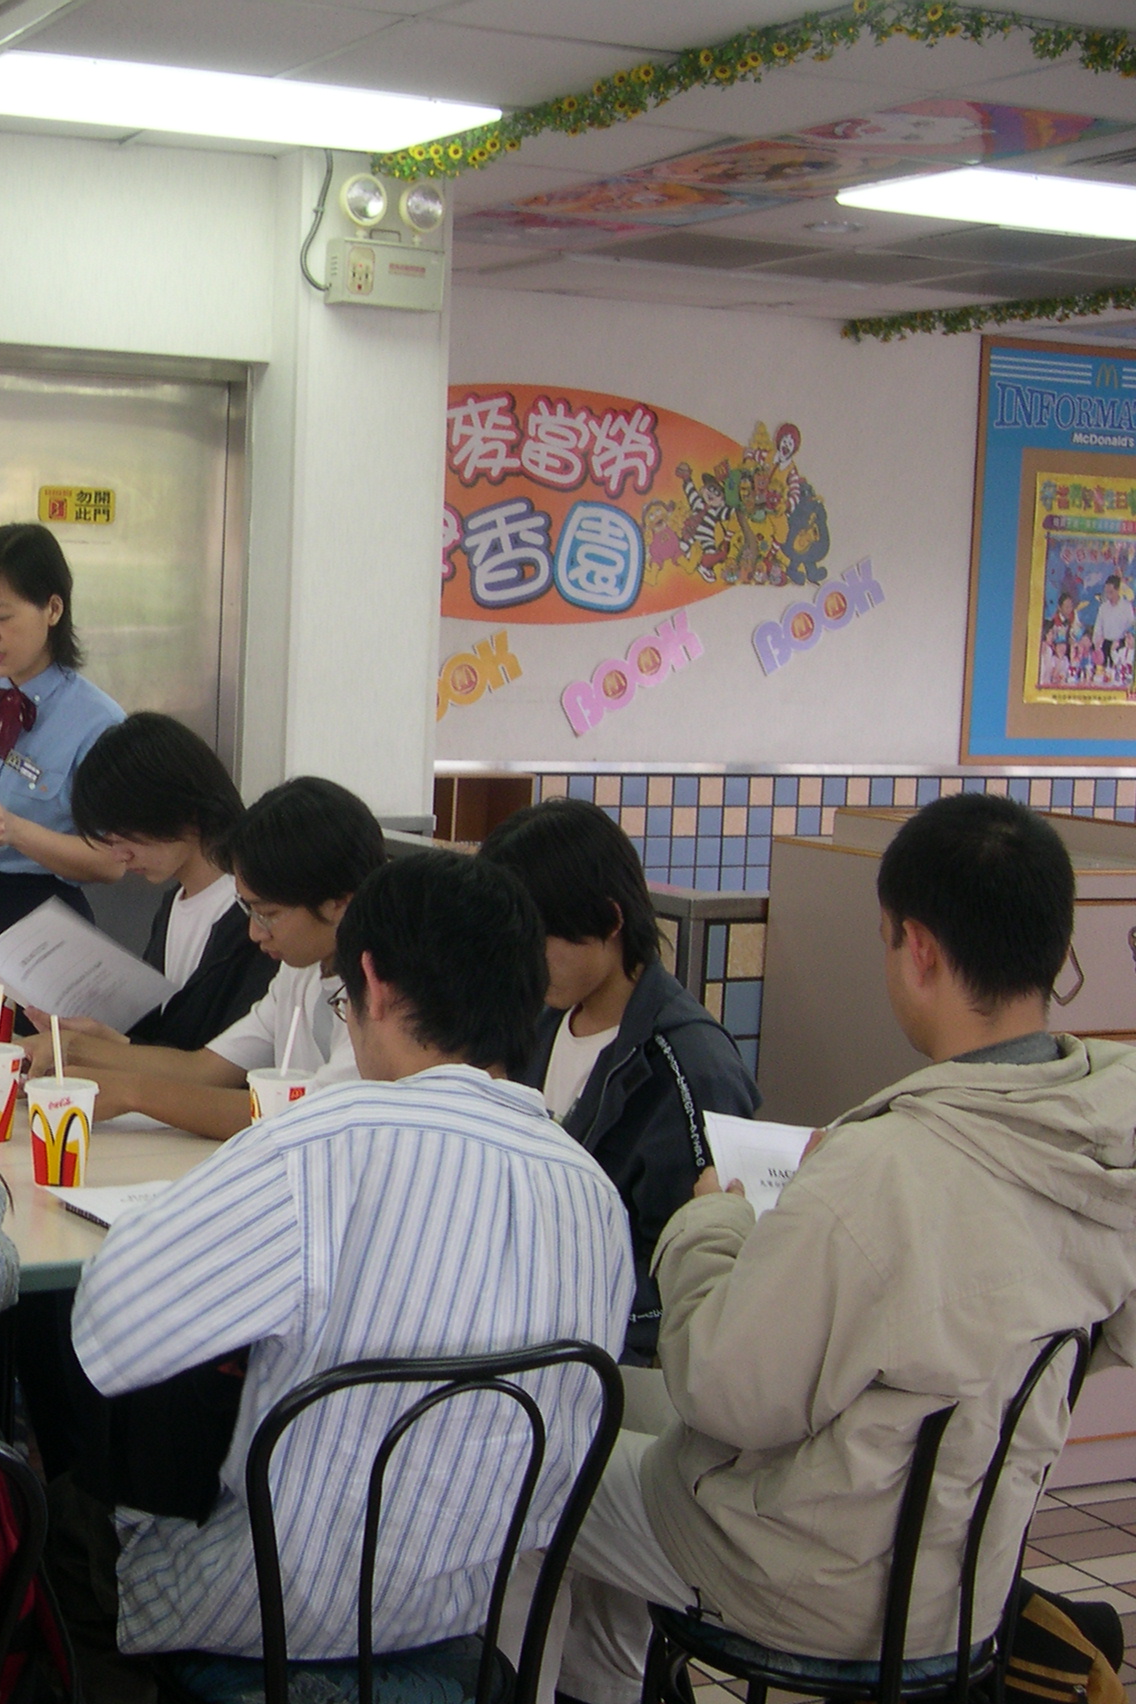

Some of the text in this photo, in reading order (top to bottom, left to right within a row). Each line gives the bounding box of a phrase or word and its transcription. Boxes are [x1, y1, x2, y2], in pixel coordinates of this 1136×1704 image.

[1071, 431, 1135, 448] McDonald's
[561, 608, 705, 738] BOOK
[752, 557, 886, 677] BOOK
